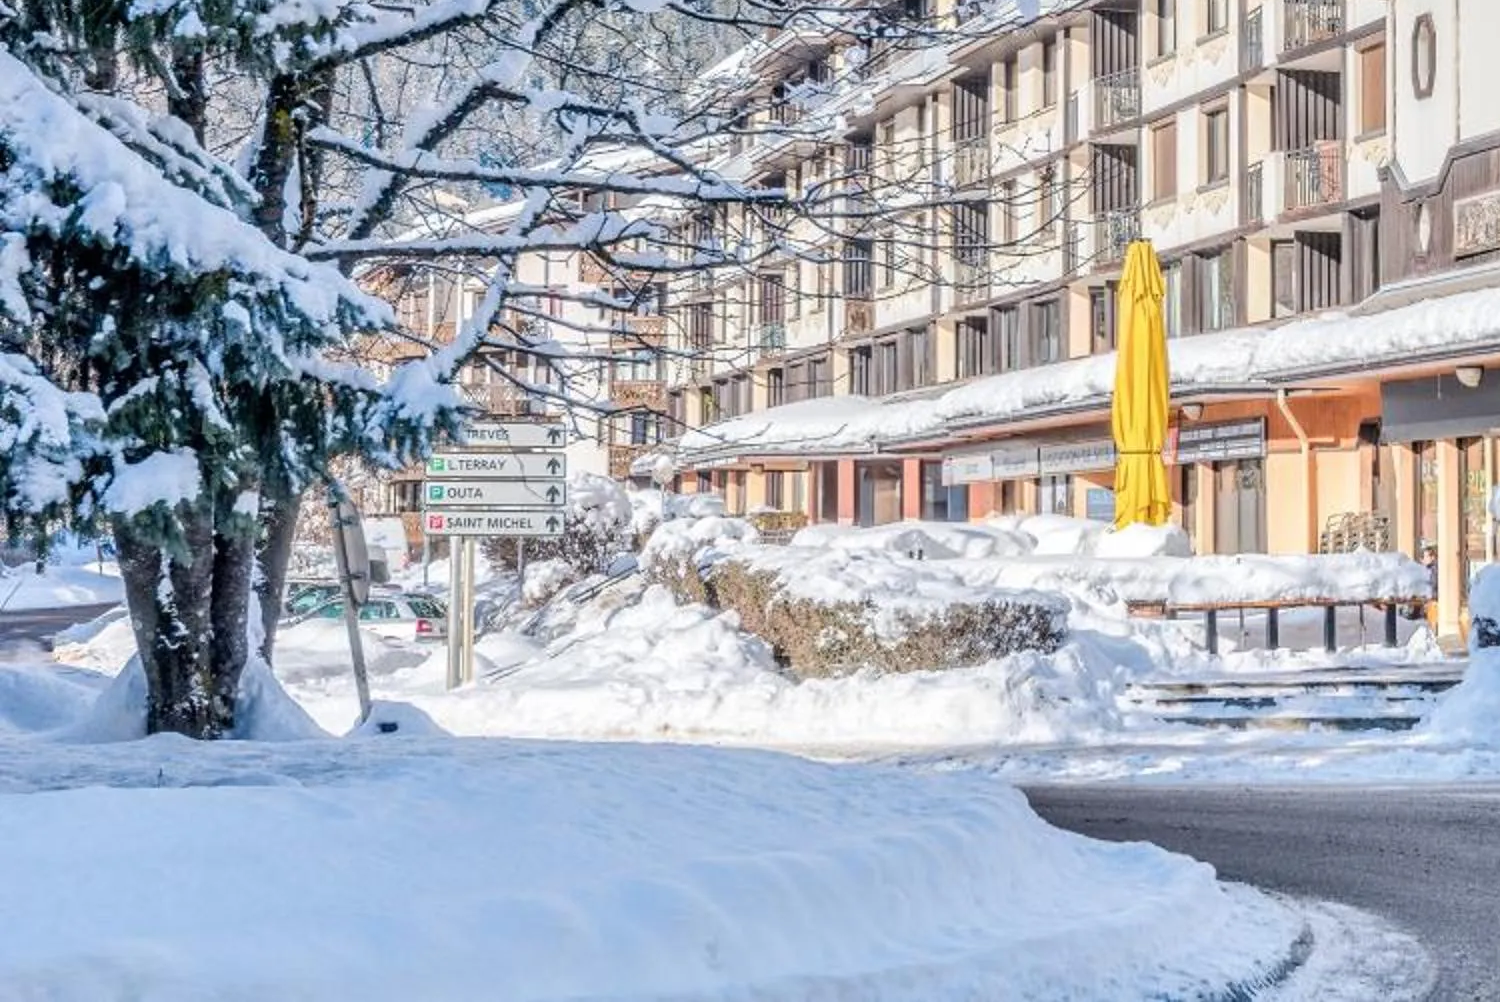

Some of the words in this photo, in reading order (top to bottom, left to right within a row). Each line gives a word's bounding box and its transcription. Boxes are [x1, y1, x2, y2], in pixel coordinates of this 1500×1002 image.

[447, 488, 483, 499] OUTA
[447, 518, 482, 529] SAINT
[487, 518, 533, 529] MICHEL
